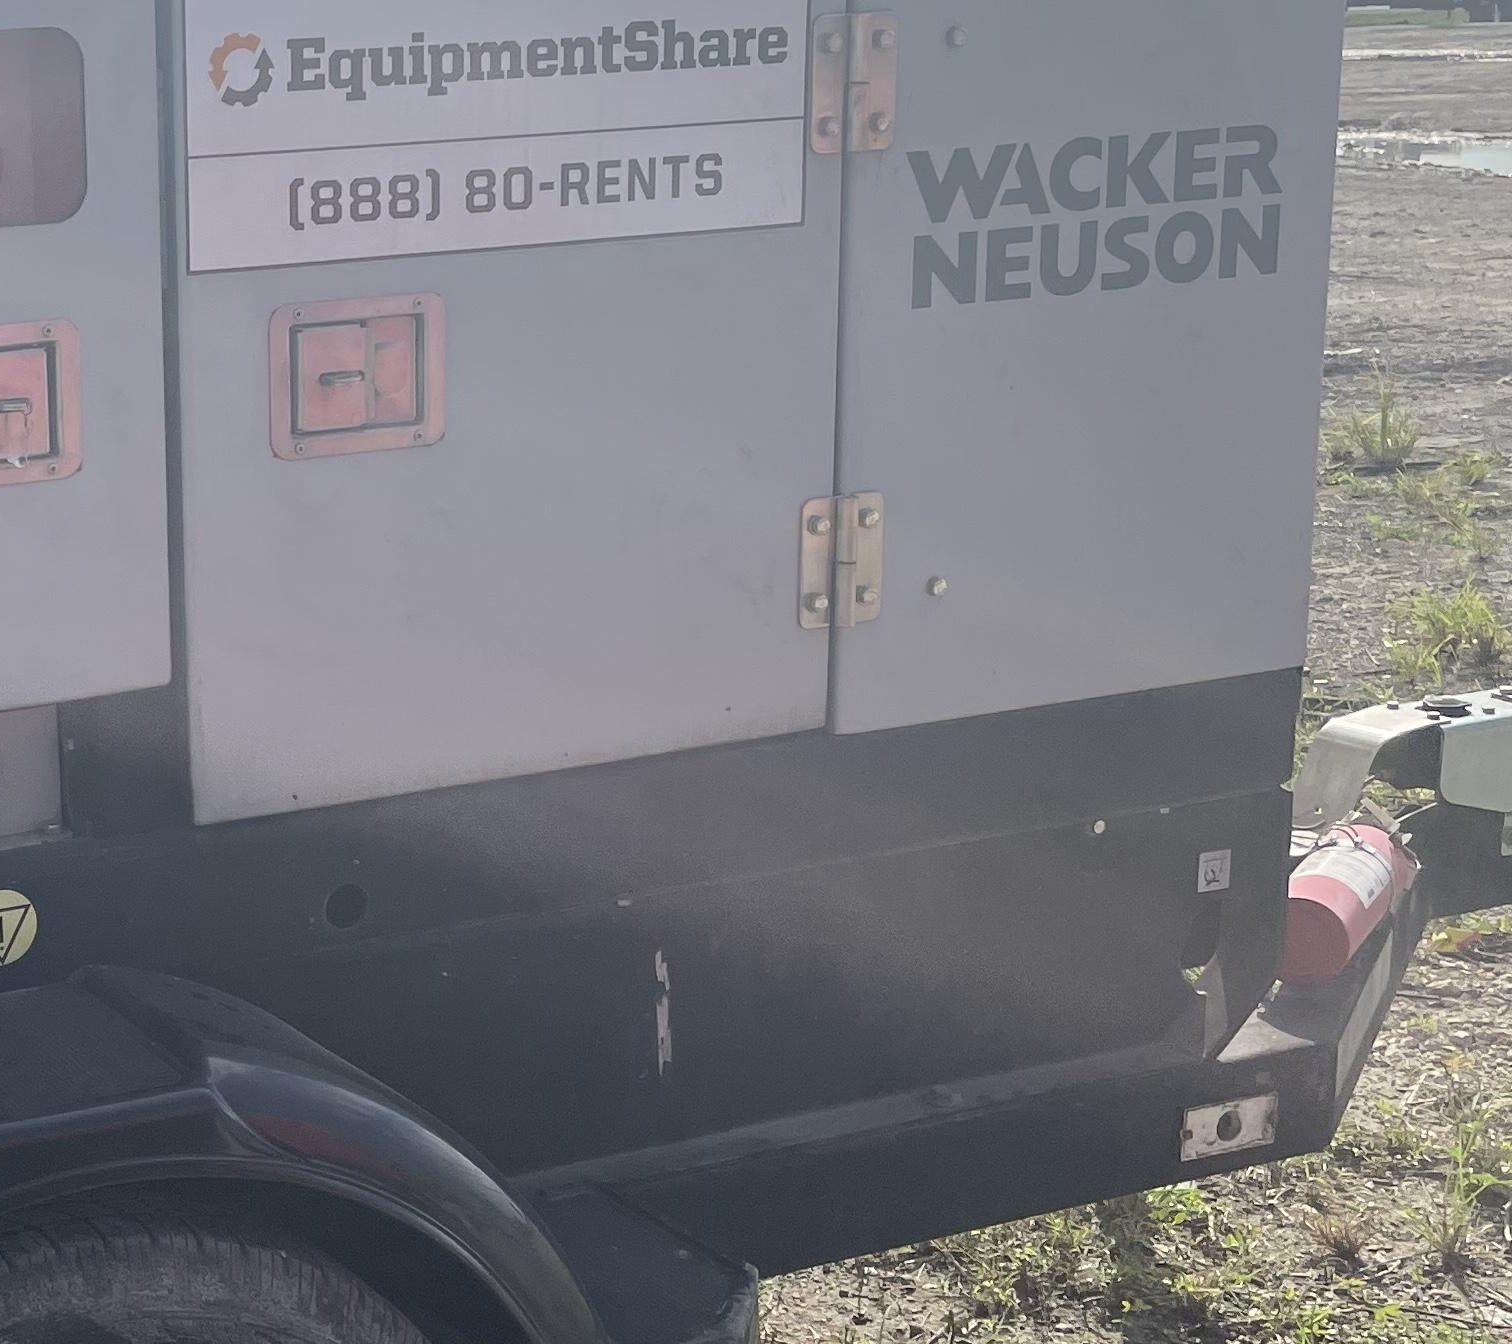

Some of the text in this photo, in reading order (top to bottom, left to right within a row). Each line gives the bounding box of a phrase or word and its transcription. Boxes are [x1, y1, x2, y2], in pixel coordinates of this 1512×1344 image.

[287, 20, 789, 102] EquipmentShare
[289, 153, 723, 231] (888) 80-RENTS
[906, 124, 1283, 223] WACKER
[911, 204, 1281, 309] NEUSON
